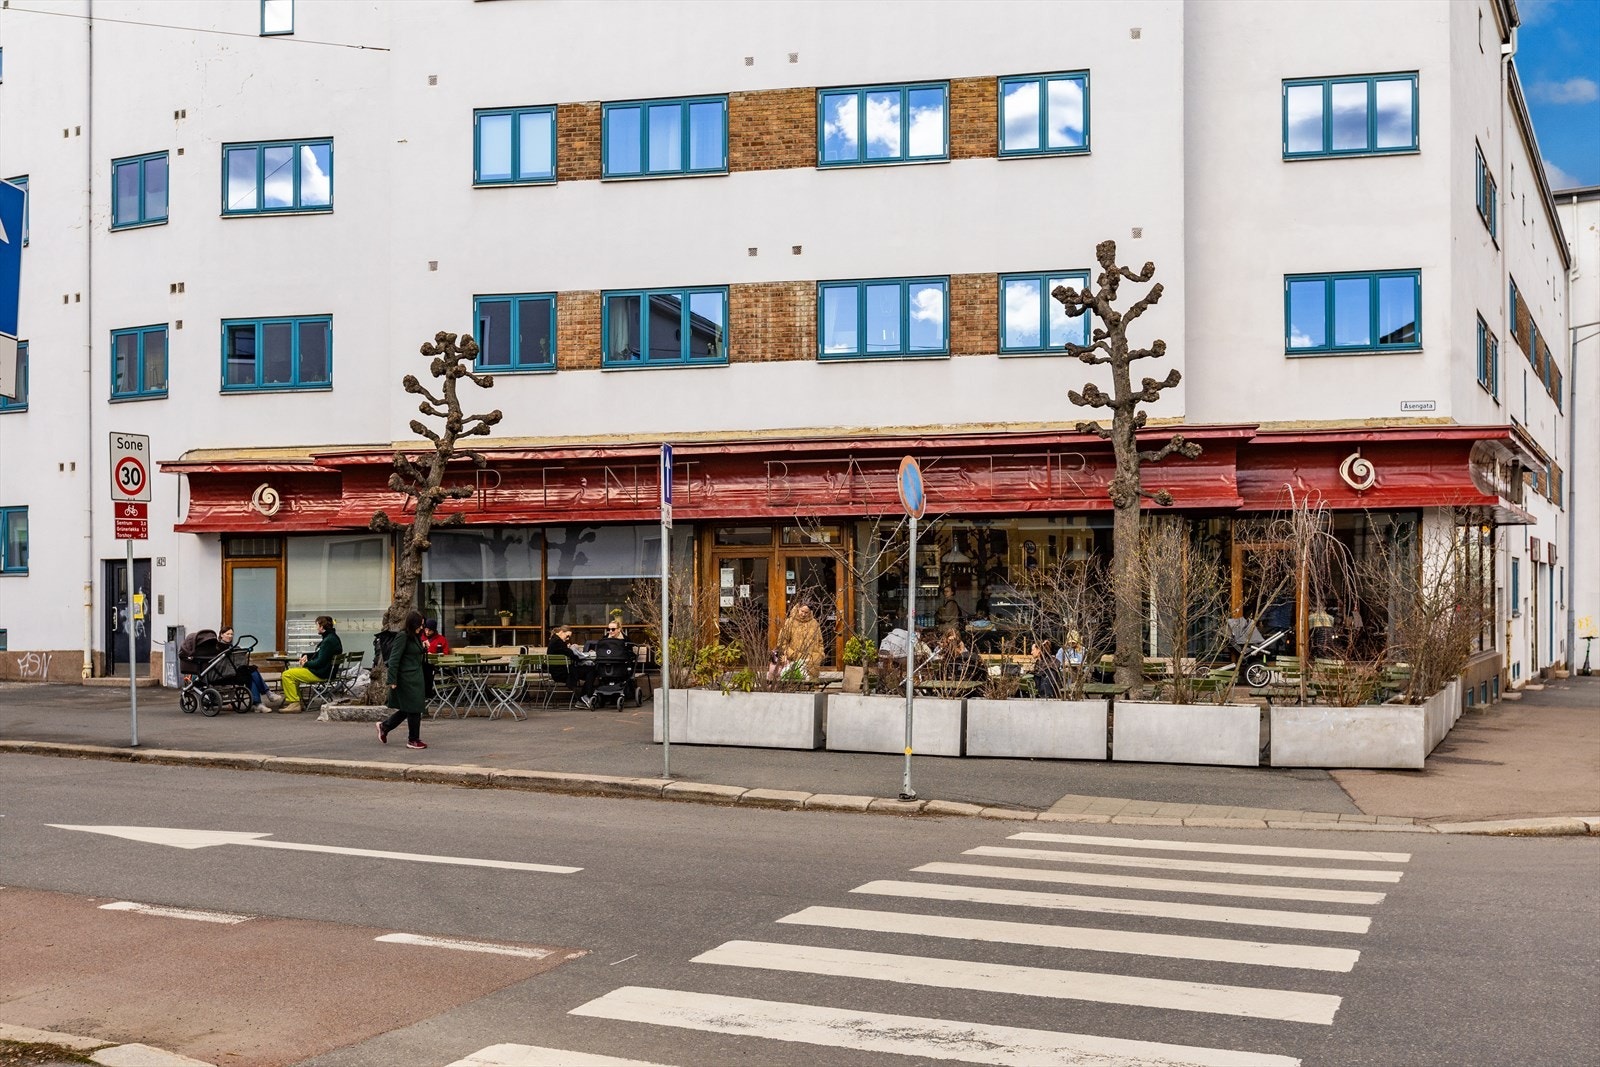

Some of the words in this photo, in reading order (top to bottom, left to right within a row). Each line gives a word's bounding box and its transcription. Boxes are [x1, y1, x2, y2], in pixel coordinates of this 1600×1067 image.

[117, 437, 143, 451] Sone
[121, 467, 141, 486] 30
[402, 461, 700, 511] PENT
